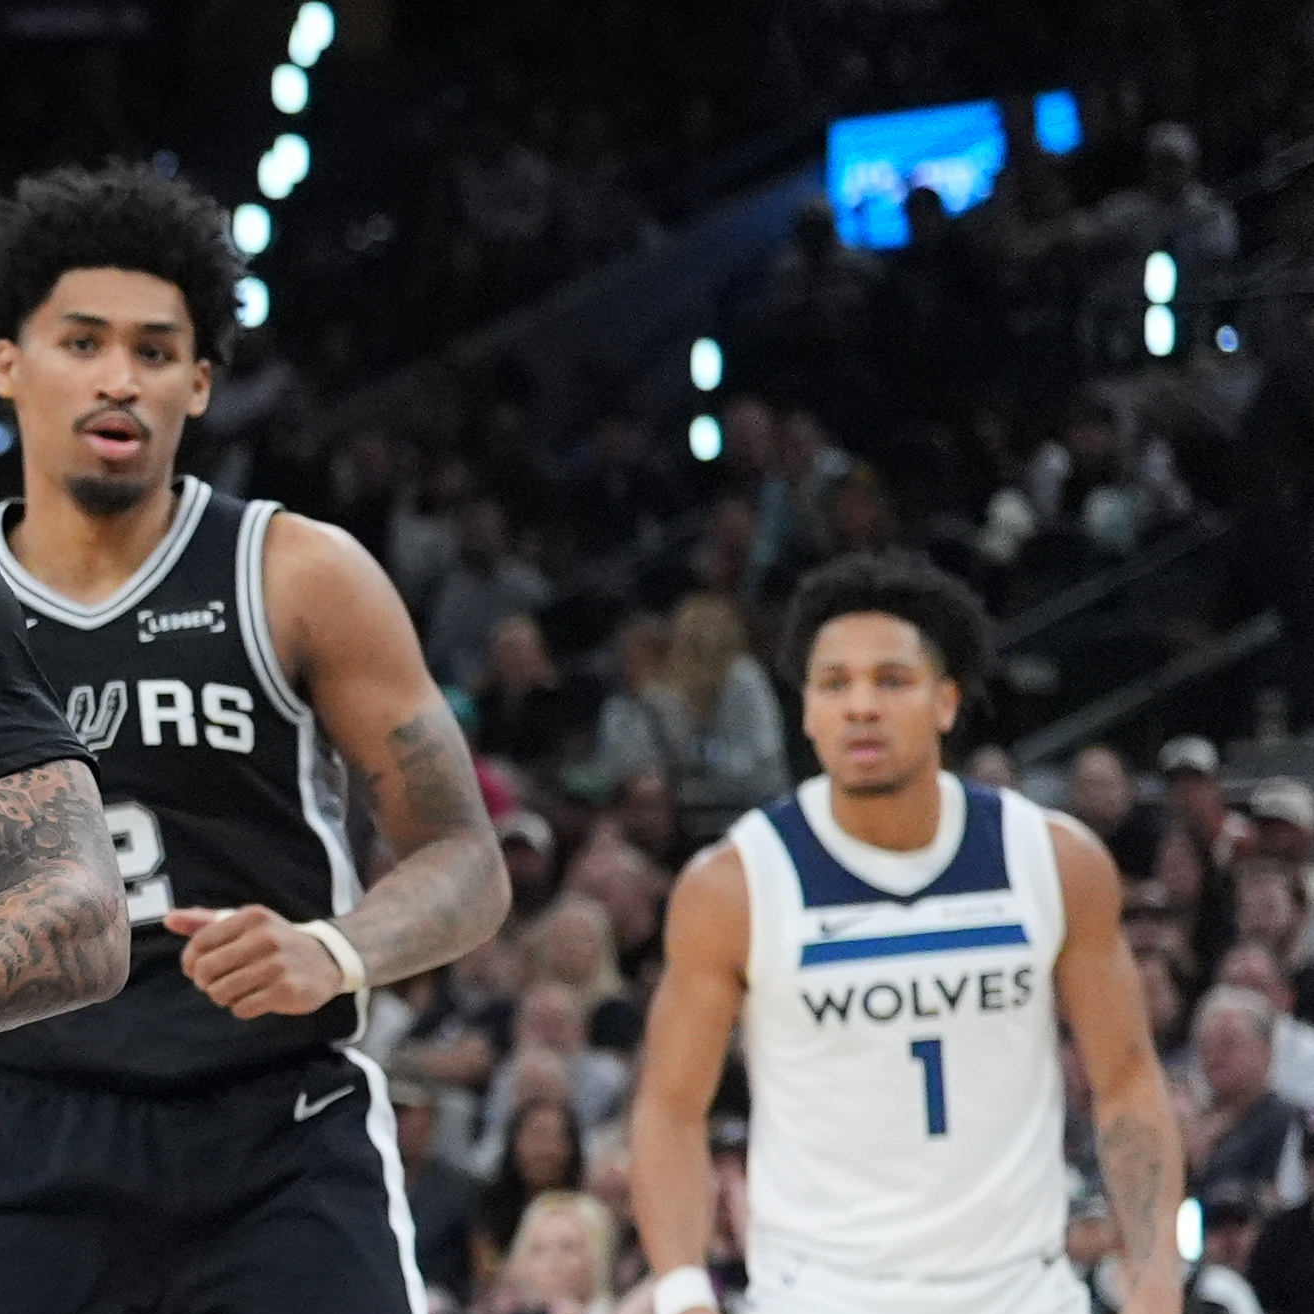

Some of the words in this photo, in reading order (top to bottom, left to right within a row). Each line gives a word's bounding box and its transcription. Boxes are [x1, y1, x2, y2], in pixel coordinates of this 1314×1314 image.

[147, 609, 214, 634] LEDGER
[66, 679, 255, 754] URS
[802, 966, 1033, 1025] WOLVES
[910, 1038, 948, 1138] 1
